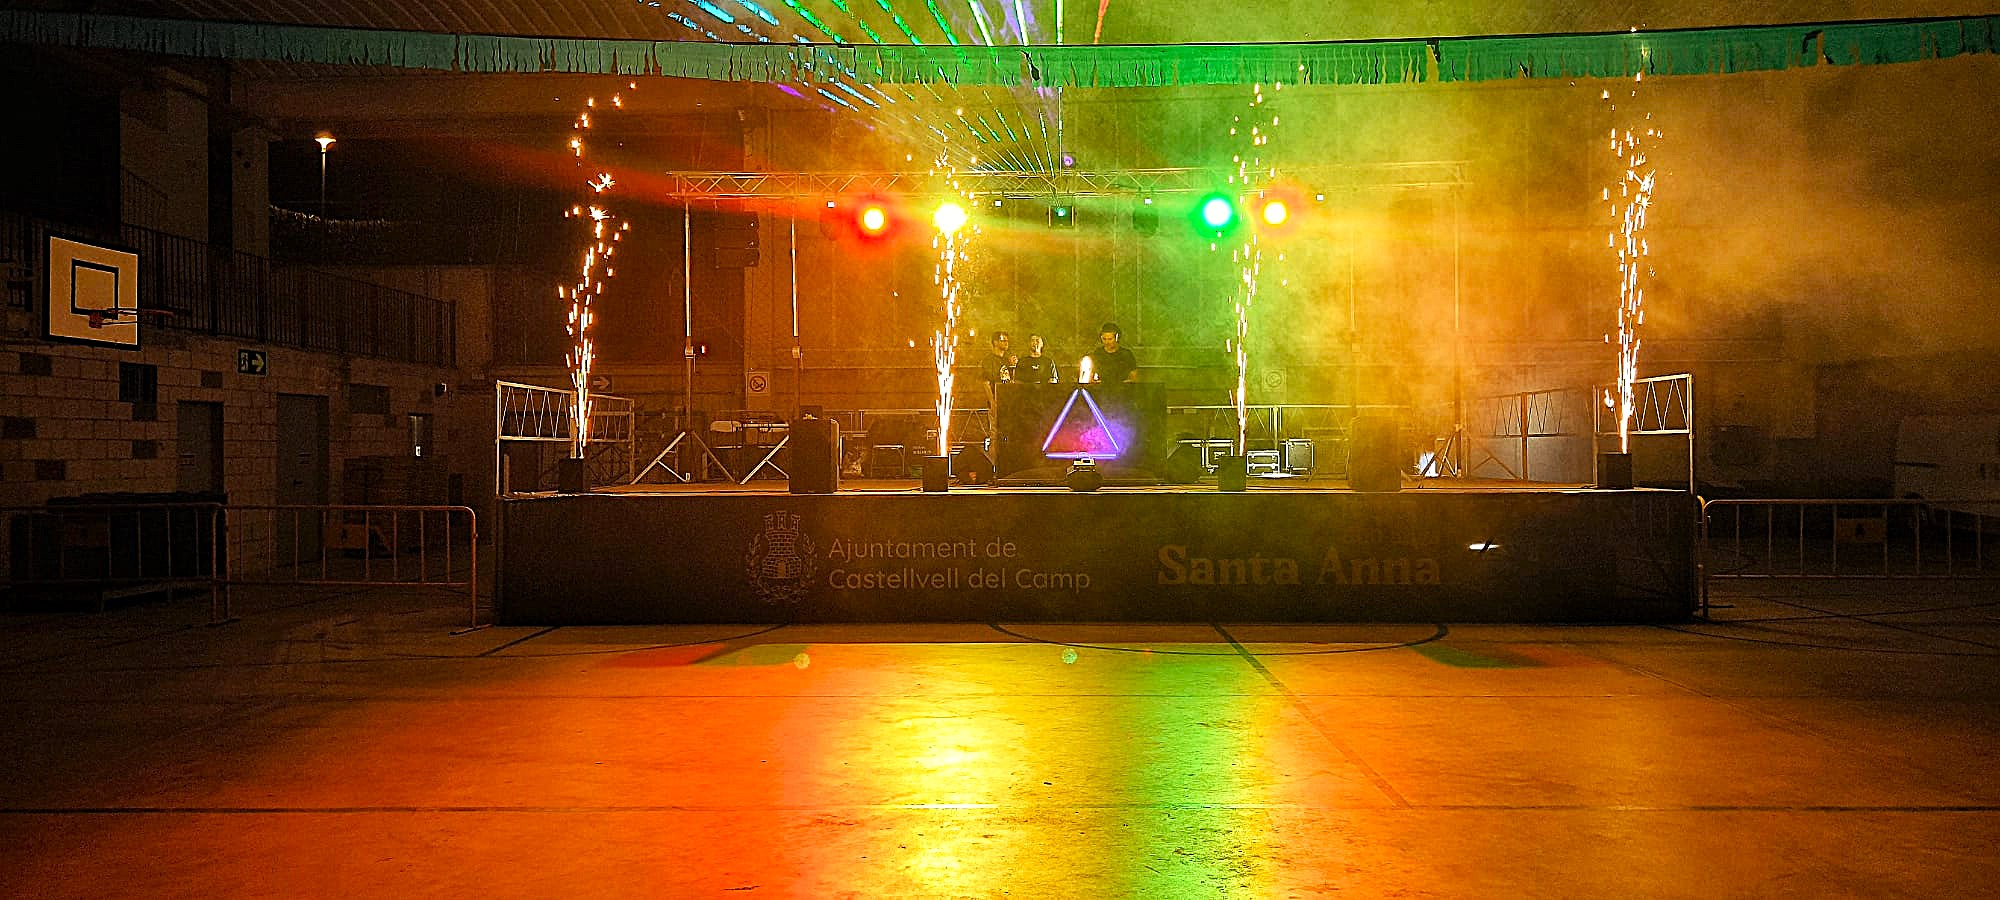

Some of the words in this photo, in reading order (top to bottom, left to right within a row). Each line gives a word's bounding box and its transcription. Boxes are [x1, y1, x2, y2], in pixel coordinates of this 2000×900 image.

[828, 537, 977, 562] Ajuntament
[985, 538, 1017, 559] de
[1157, 544, 1300, 585] Santa
[1318, 545, 1441, 585] Anna
[828, 567, 960, 590] Castellvell
[967, 567, 1007, 590] del
[1015, 568, 1091, 594] Camp
